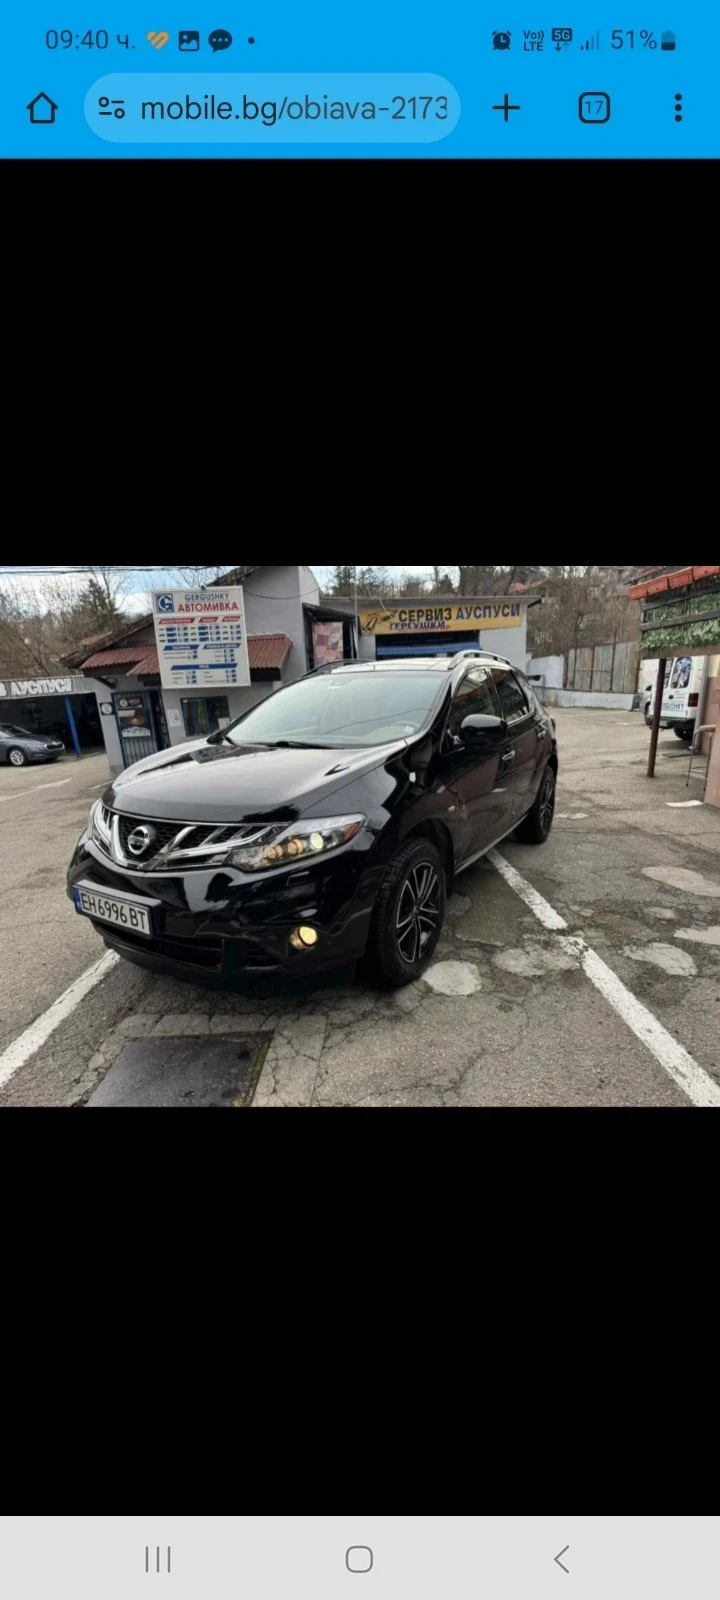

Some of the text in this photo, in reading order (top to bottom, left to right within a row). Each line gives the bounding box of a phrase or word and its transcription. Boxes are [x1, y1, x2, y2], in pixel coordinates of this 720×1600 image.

[45, 29, 109, 51] 09:40
[554, 30, 570, 40] 5G
[611, 30, 657, 50] 51%
[523, 41, 544, 52] LTE
[140, 94, 449, 125] mobile.bg/obiava-2173
[585, 100, 604, 114] 17
[184, 593, 229, 602] GERGUSHKY
[178, 601, 239, 613] АВТОМИВКА
[398, 603, 520, 622] СЕРВИЗ АУСПУСИ
